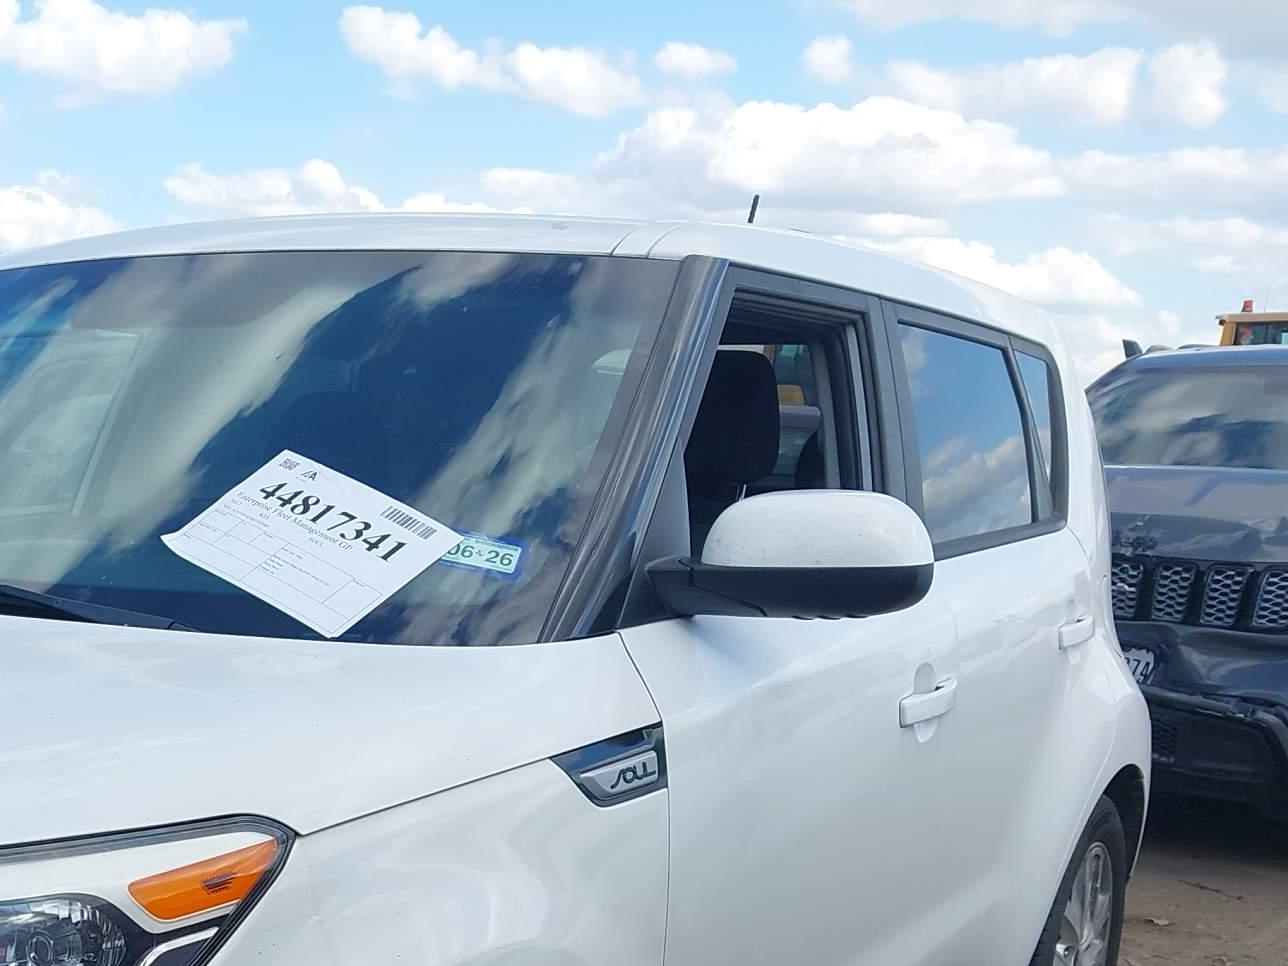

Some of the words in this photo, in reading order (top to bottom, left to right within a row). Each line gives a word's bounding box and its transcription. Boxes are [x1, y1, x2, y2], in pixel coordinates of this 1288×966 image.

[236, 491, 273, 511] Enterprise
[272, 507, 292, 521] Fleet
[292, 517, 339, 544] Management
[259, 482, 408, 562] 44817341
[484, 550, 514, 567] 26
[610, 761, 657, 790] SOUL
